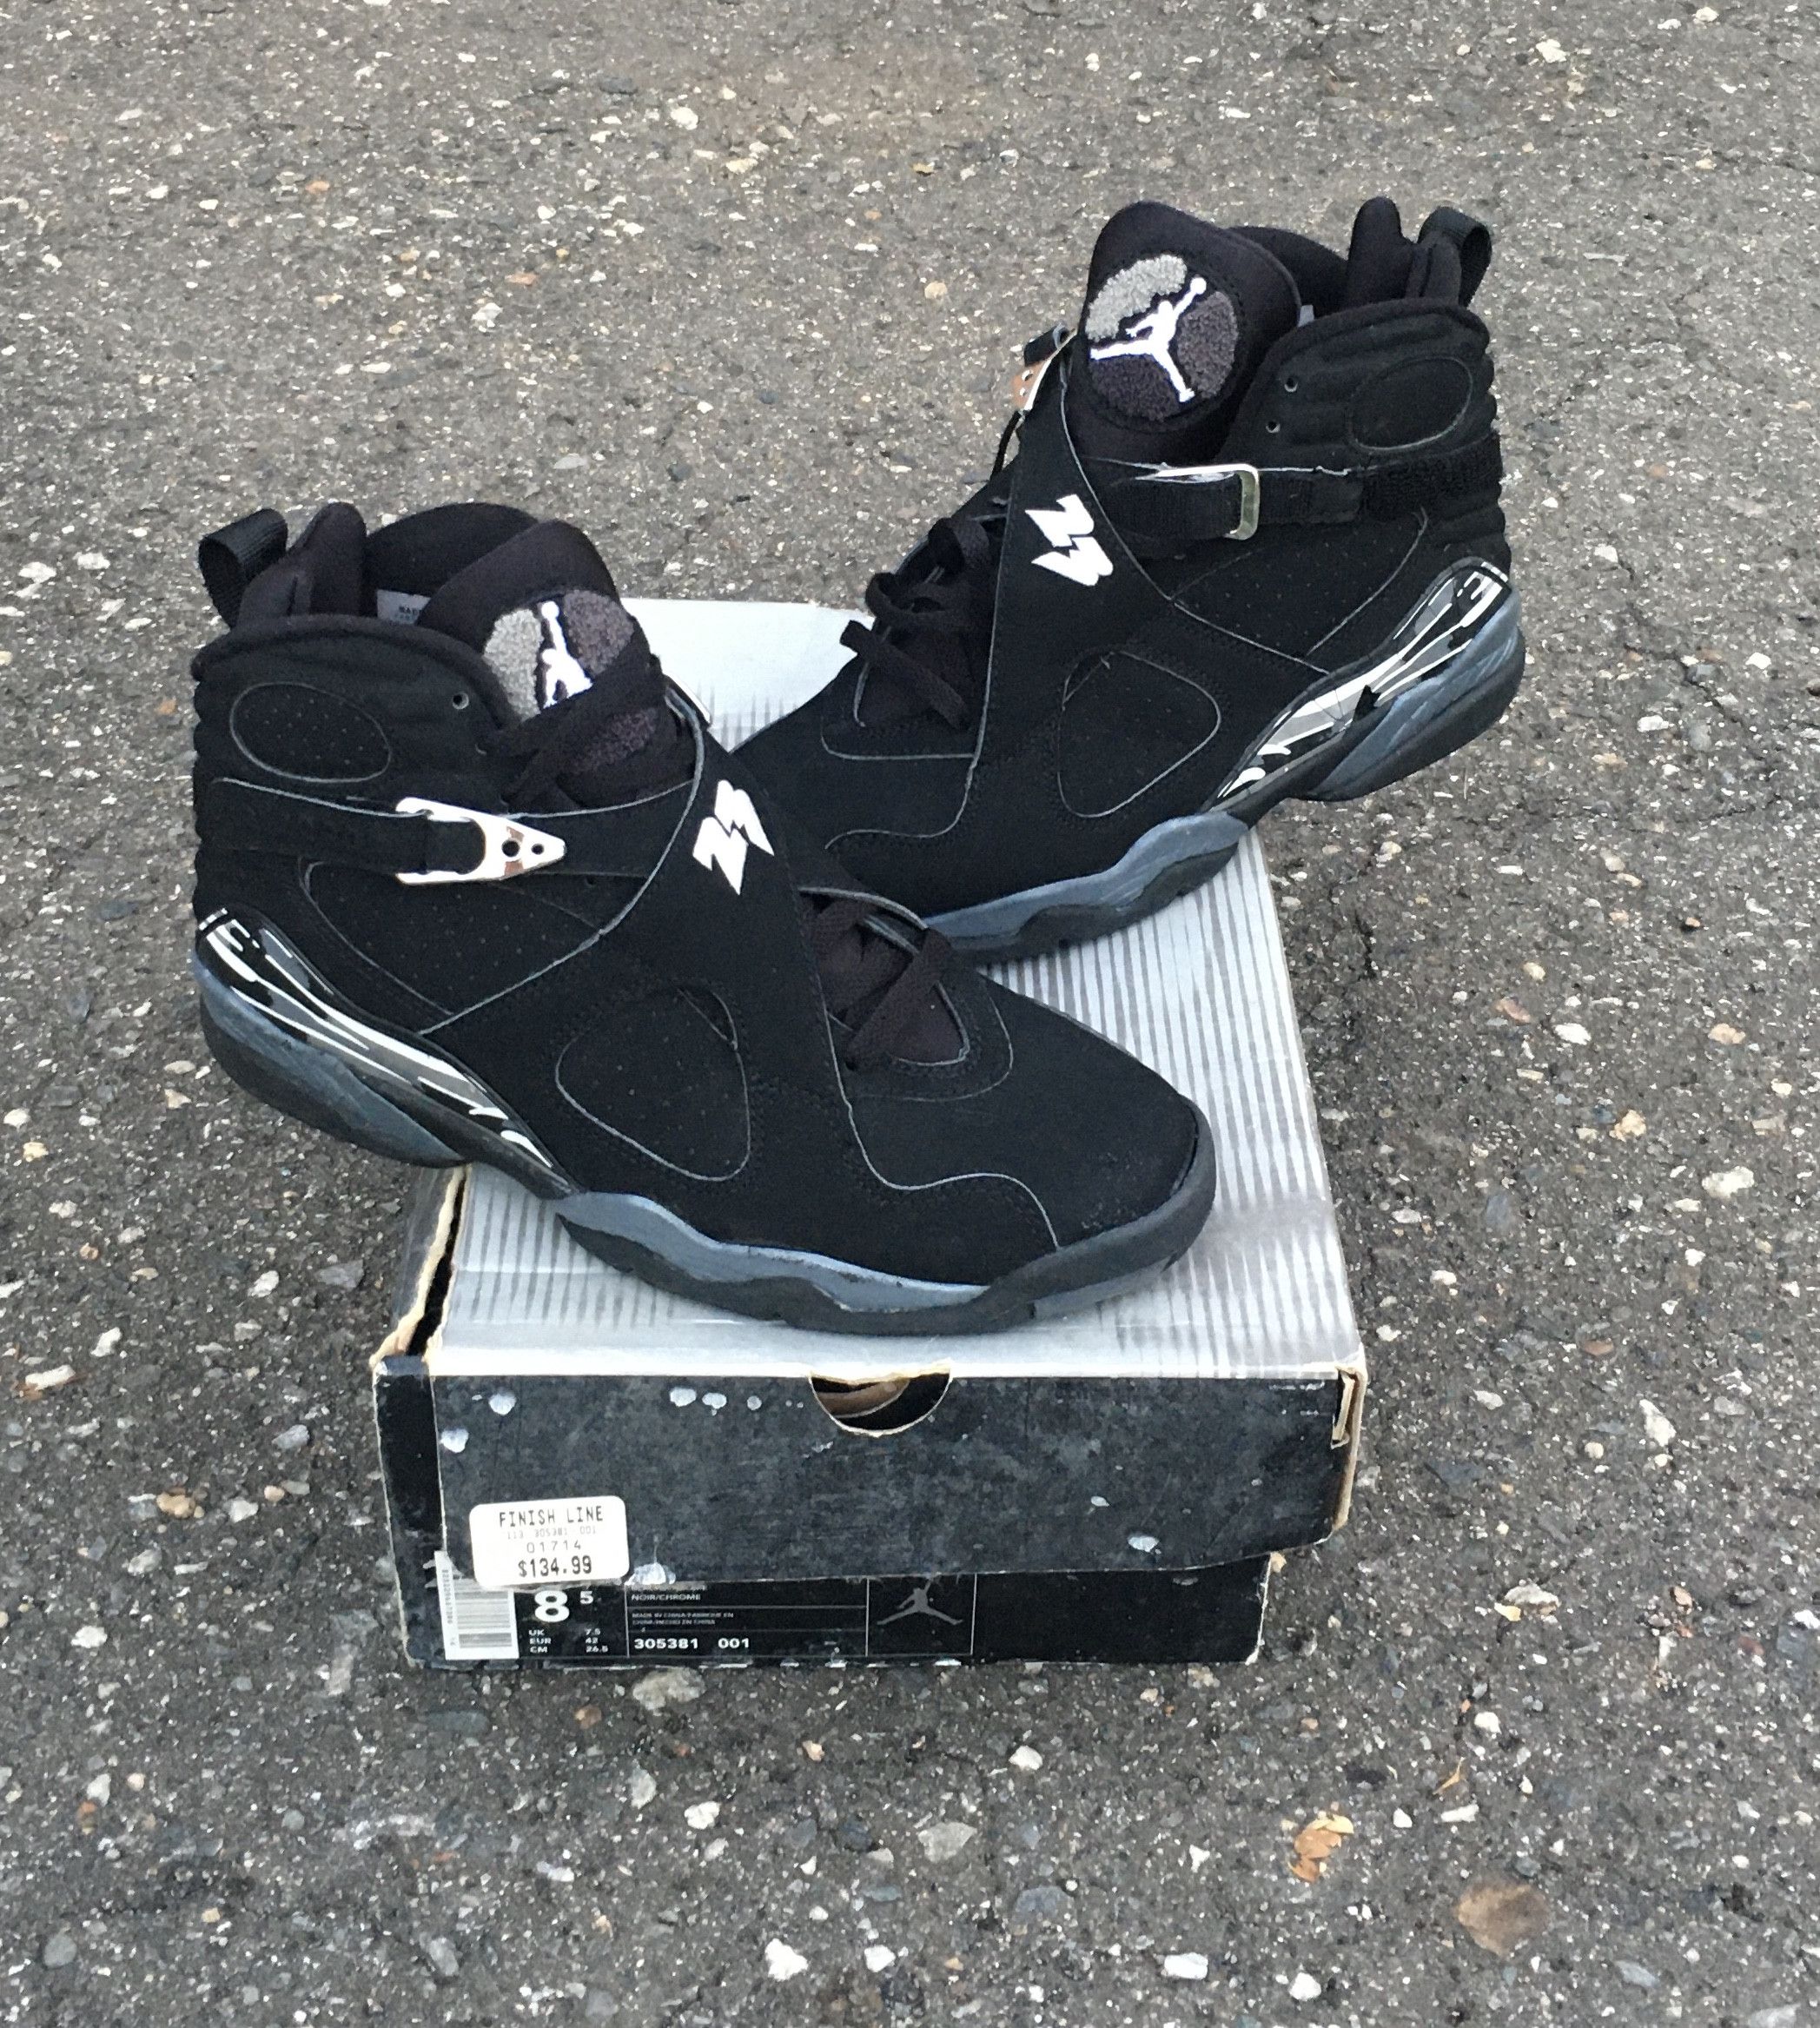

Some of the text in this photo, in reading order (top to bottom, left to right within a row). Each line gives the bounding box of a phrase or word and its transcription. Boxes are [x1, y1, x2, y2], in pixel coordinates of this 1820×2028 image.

[500, 1506, 604, 1528] FINISH LINE
[526, 1540, 581, 1554] 01714
[518, 1554, 592, 1578] $134.99
[534, 1589, 593, 1623] 8 5
[633, 1637, 750, 1649] 305381 001
